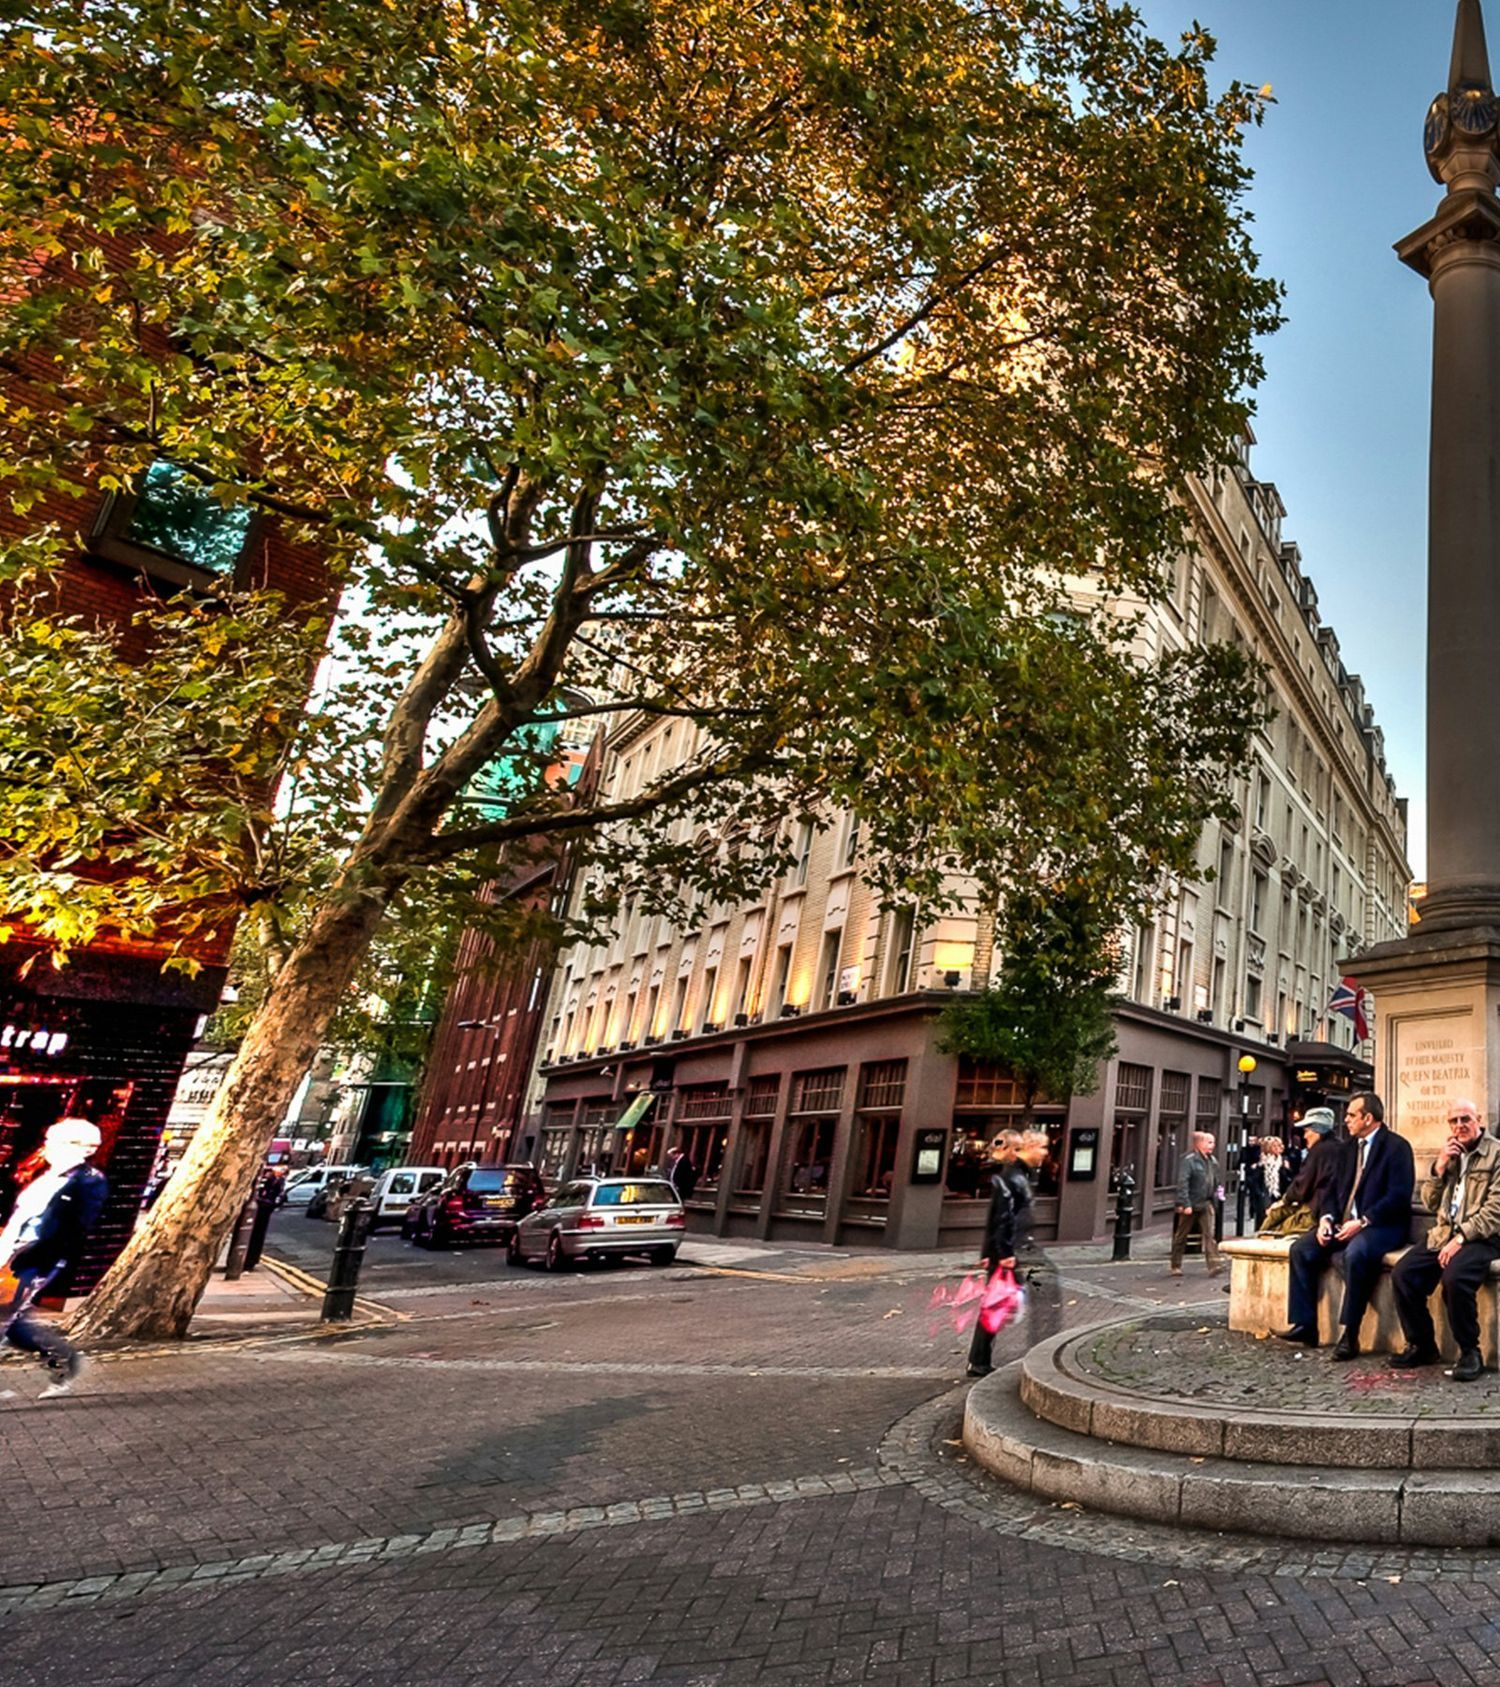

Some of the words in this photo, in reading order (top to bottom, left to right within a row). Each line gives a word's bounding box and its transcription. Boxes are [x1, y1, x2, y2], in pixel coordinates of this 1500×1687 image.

[1415, 1040, 1454, 1050] UNVEILED
[1431, 1053, 1464, 1064] MAJESTY
[1399, 1071, 1430, 1088] QUEEN
[1432, 1068, 1470, 1081] BEATRIX
